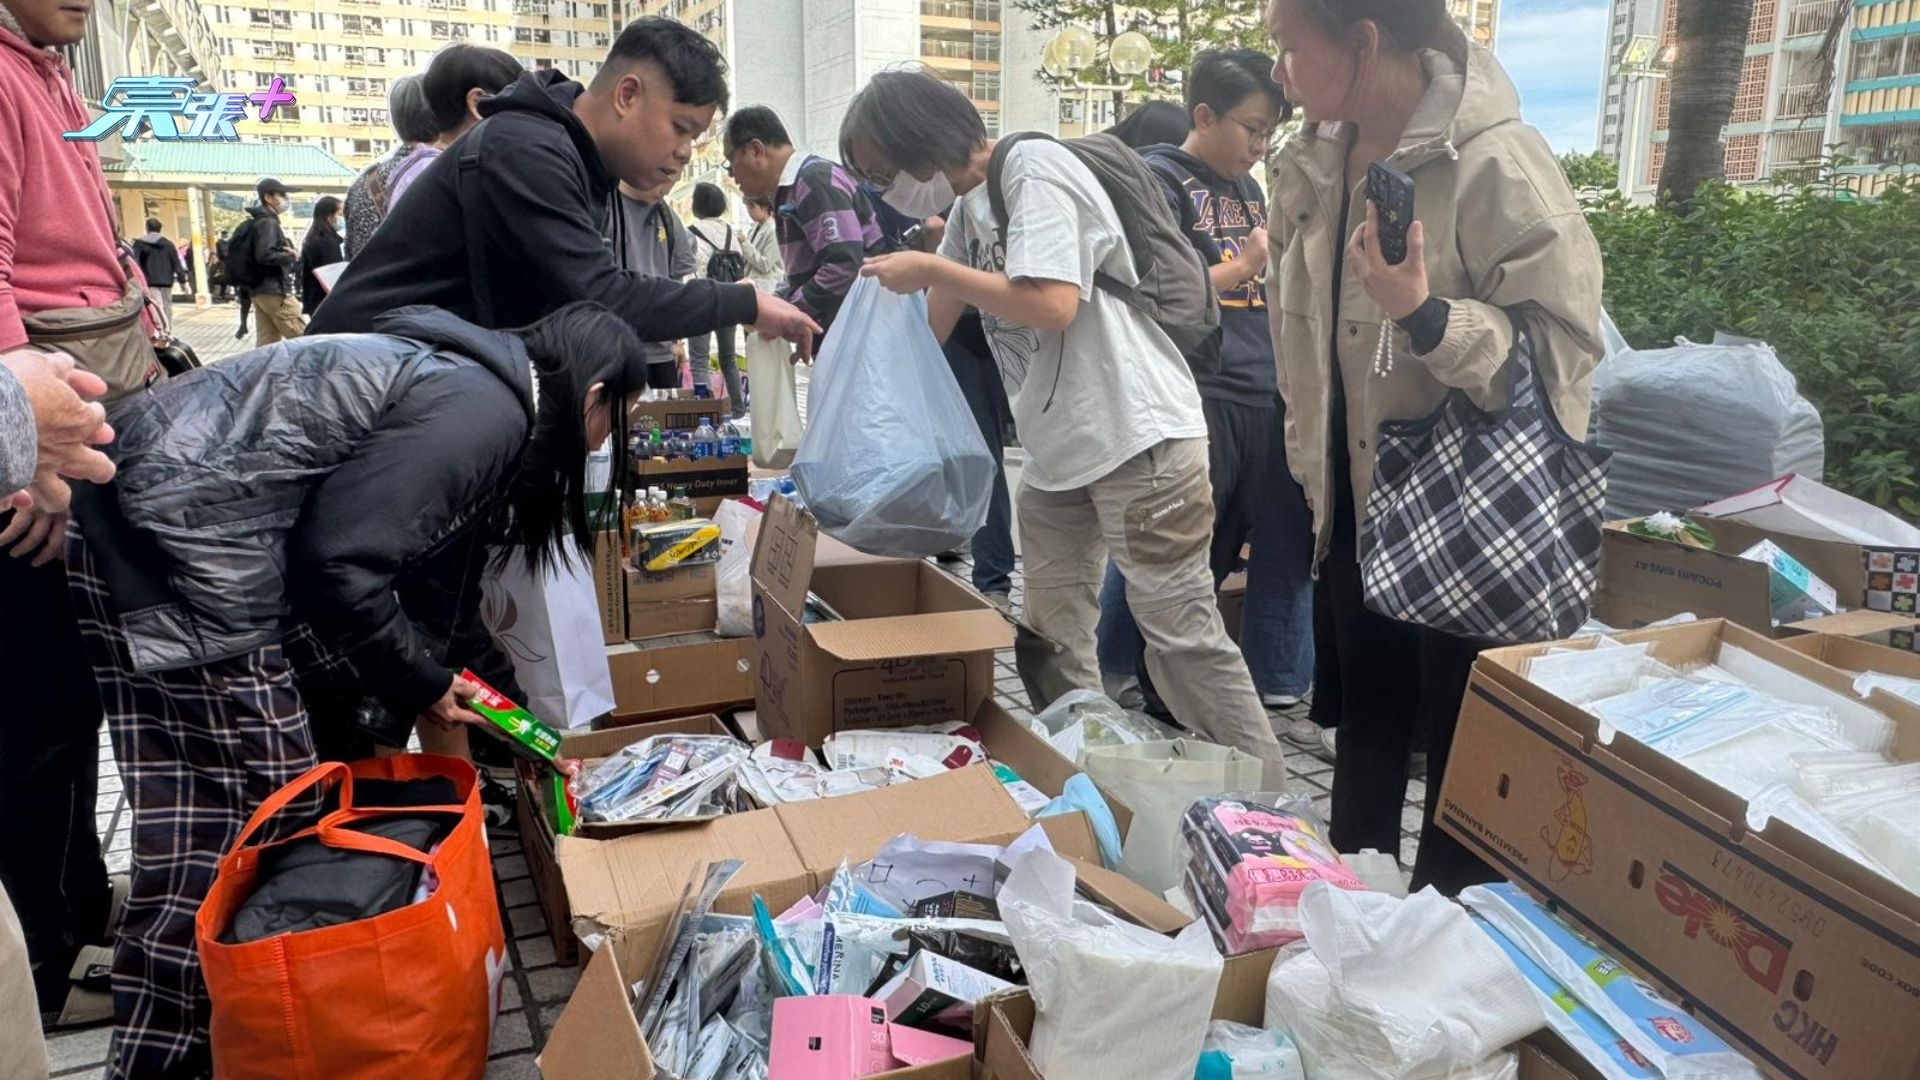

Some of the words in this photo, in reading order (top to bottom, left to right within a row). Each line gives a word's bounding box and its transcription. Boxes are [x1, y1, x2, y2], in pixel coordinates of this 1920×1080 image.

[823, 216, 840, 241] 3
[1634, 560, 1676, 577] SWEAT
[1677, 568, 1722, 589] POCARI
[1443, 797, 1485, 835] BANANAS
[1484, 827, 1528, 865] PREMIUM
[1654, 872, 1791, 995] Dole
[1772, 1001, 1839, 1066] HKC
